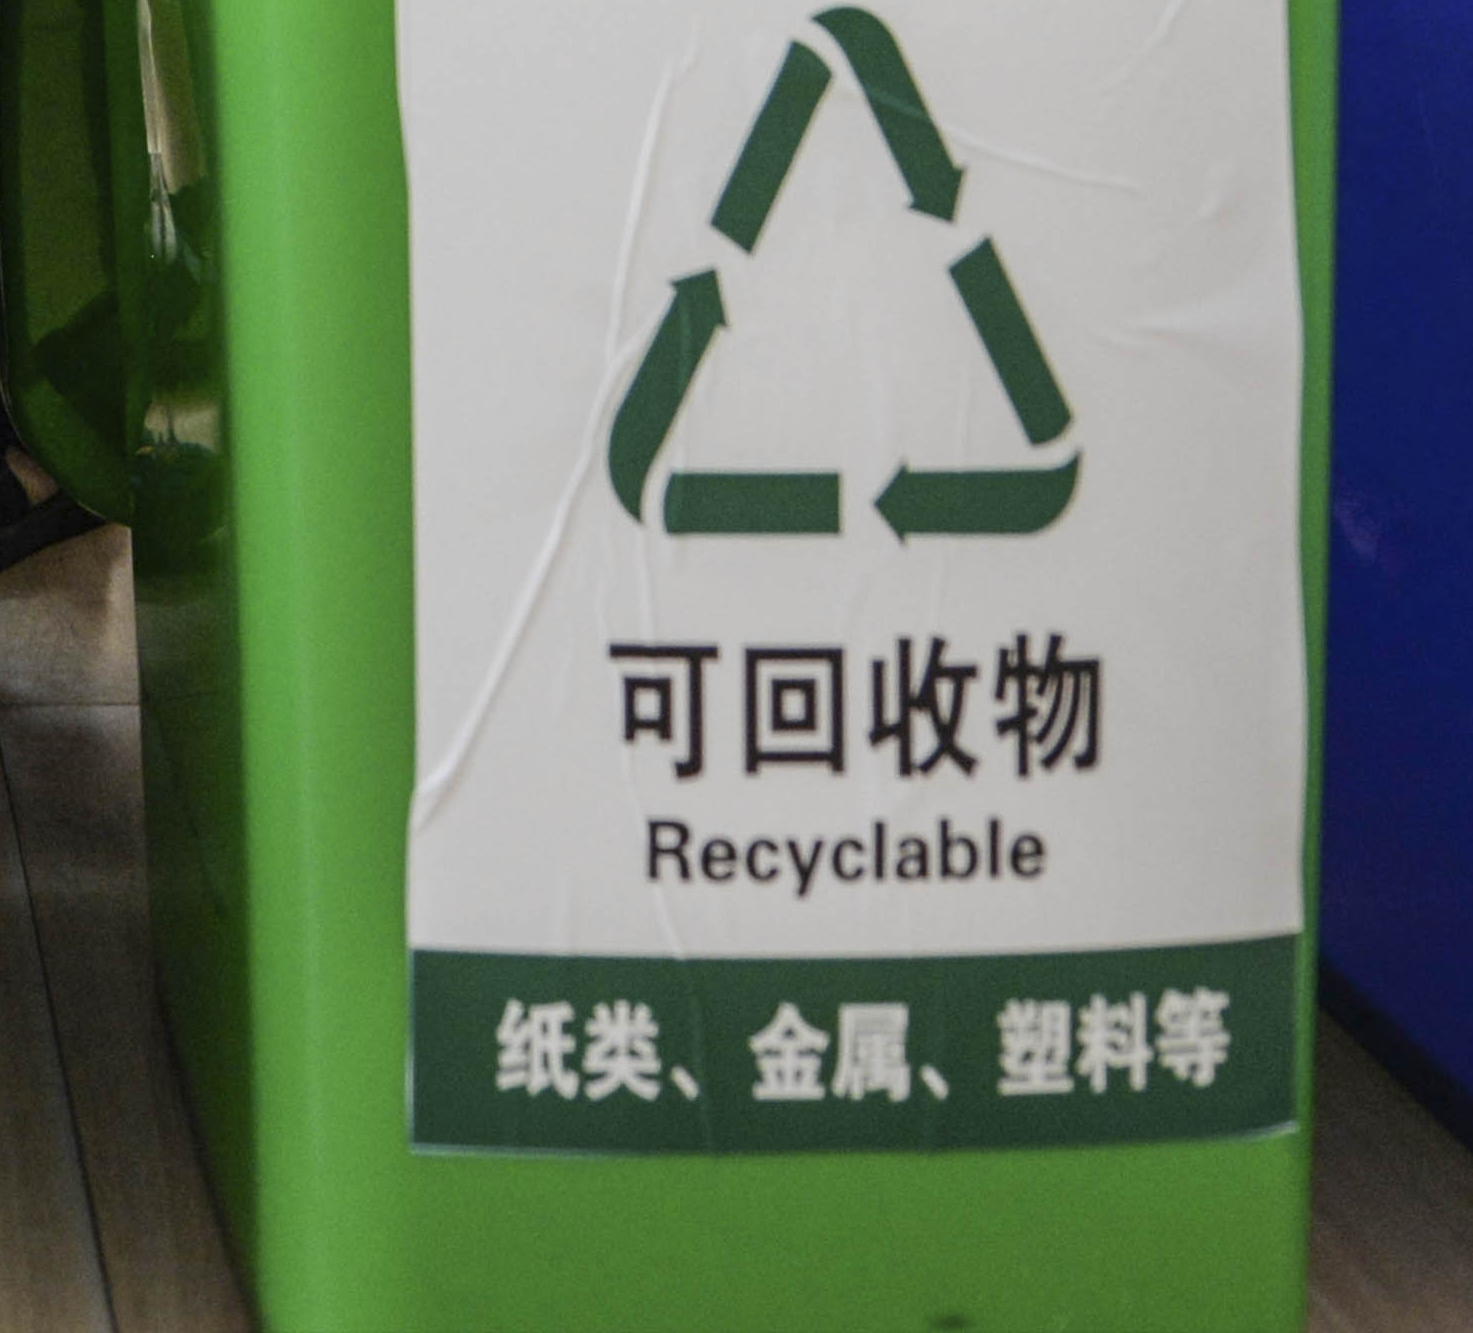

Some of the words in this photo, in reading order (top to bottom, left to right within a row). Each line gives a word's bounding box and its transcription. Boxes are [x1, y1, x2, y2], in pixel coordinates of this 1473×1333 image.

[608, 632, 1103, 781] 可回收物
[646, 817, 1048, 900] Recyclable
[495, 987, 1232, 1103] 纸类、金属、塑料等
